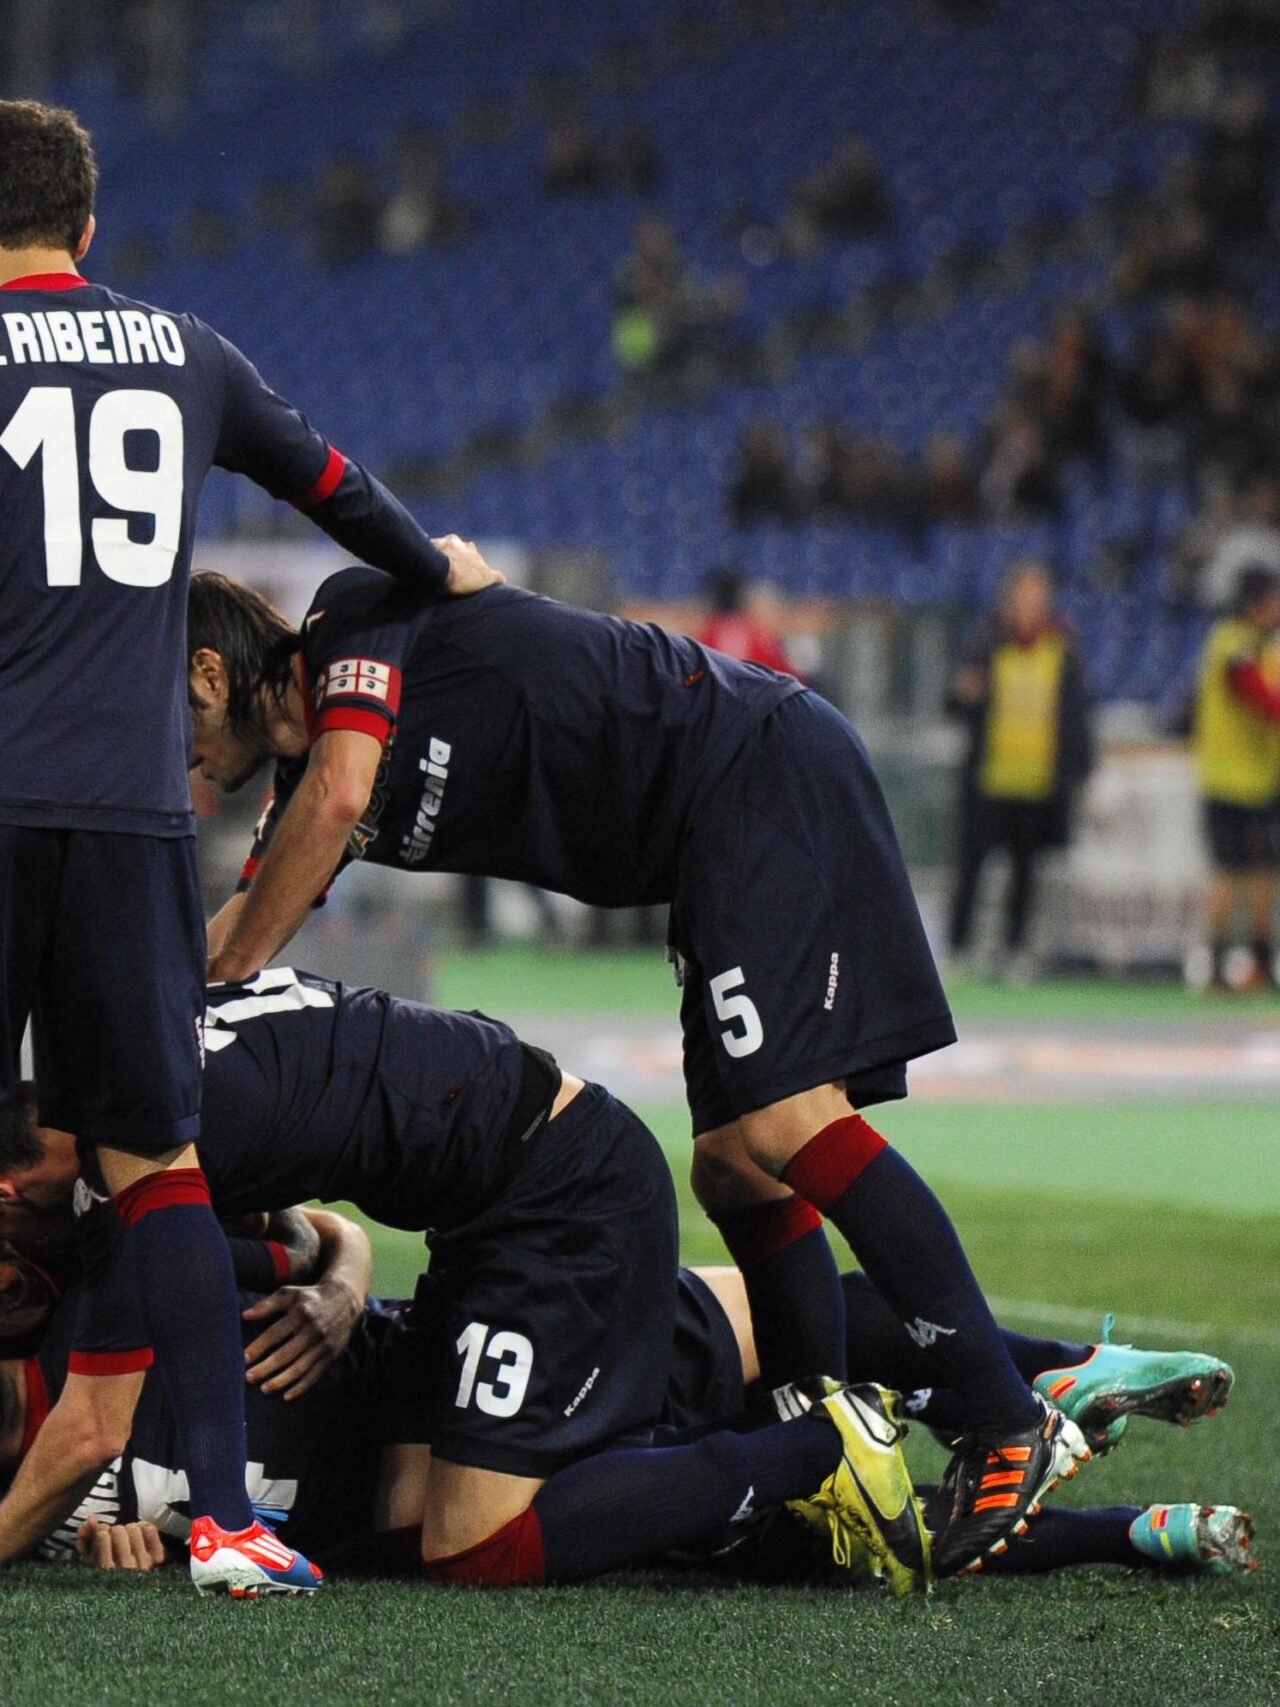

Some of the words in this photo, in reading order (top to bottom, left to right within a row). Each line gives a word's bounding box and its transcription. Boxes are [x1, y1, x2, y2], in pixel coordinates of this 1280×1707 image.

[399, 736, 452, 865] tirrenia
[709, 965, 764, 1059] 5
[823, 951, 839, 1011] Kappa
[455, 1321, 534, 1418] 13
[563, 1366, 601, 1418] Kappa
